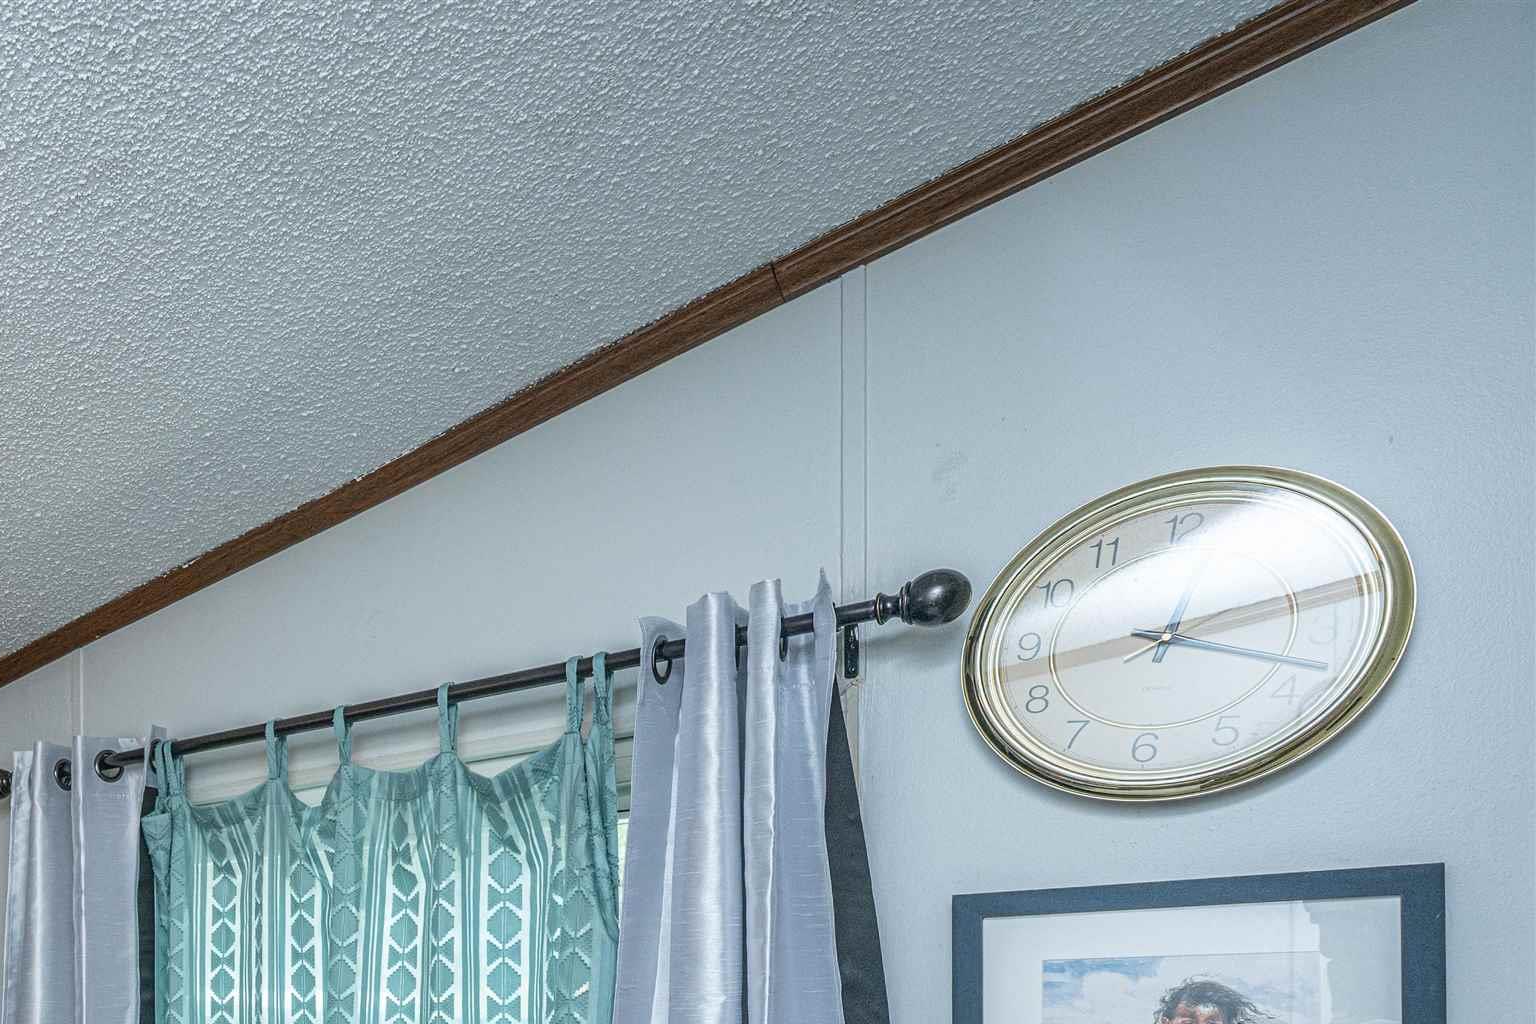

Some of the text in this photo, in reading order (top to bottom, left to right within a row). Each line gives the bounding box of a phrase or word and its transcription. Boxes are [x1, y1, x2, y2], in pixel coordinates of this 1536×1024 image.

[1164, 511, 1205, 548] 12
[1089, 536, 1120, 569] 11
[1038, 577, 1075, 610] 10
[1017, 632, 1041, 661] 9
[1024, 684, 1050, 714] 8
[1270, 675, 1299, 705] 4
[1065, 720, 1090, 750] 7
[1211, 716, 1240, 746] 5
[1131, 732, 1158, 763] 6
